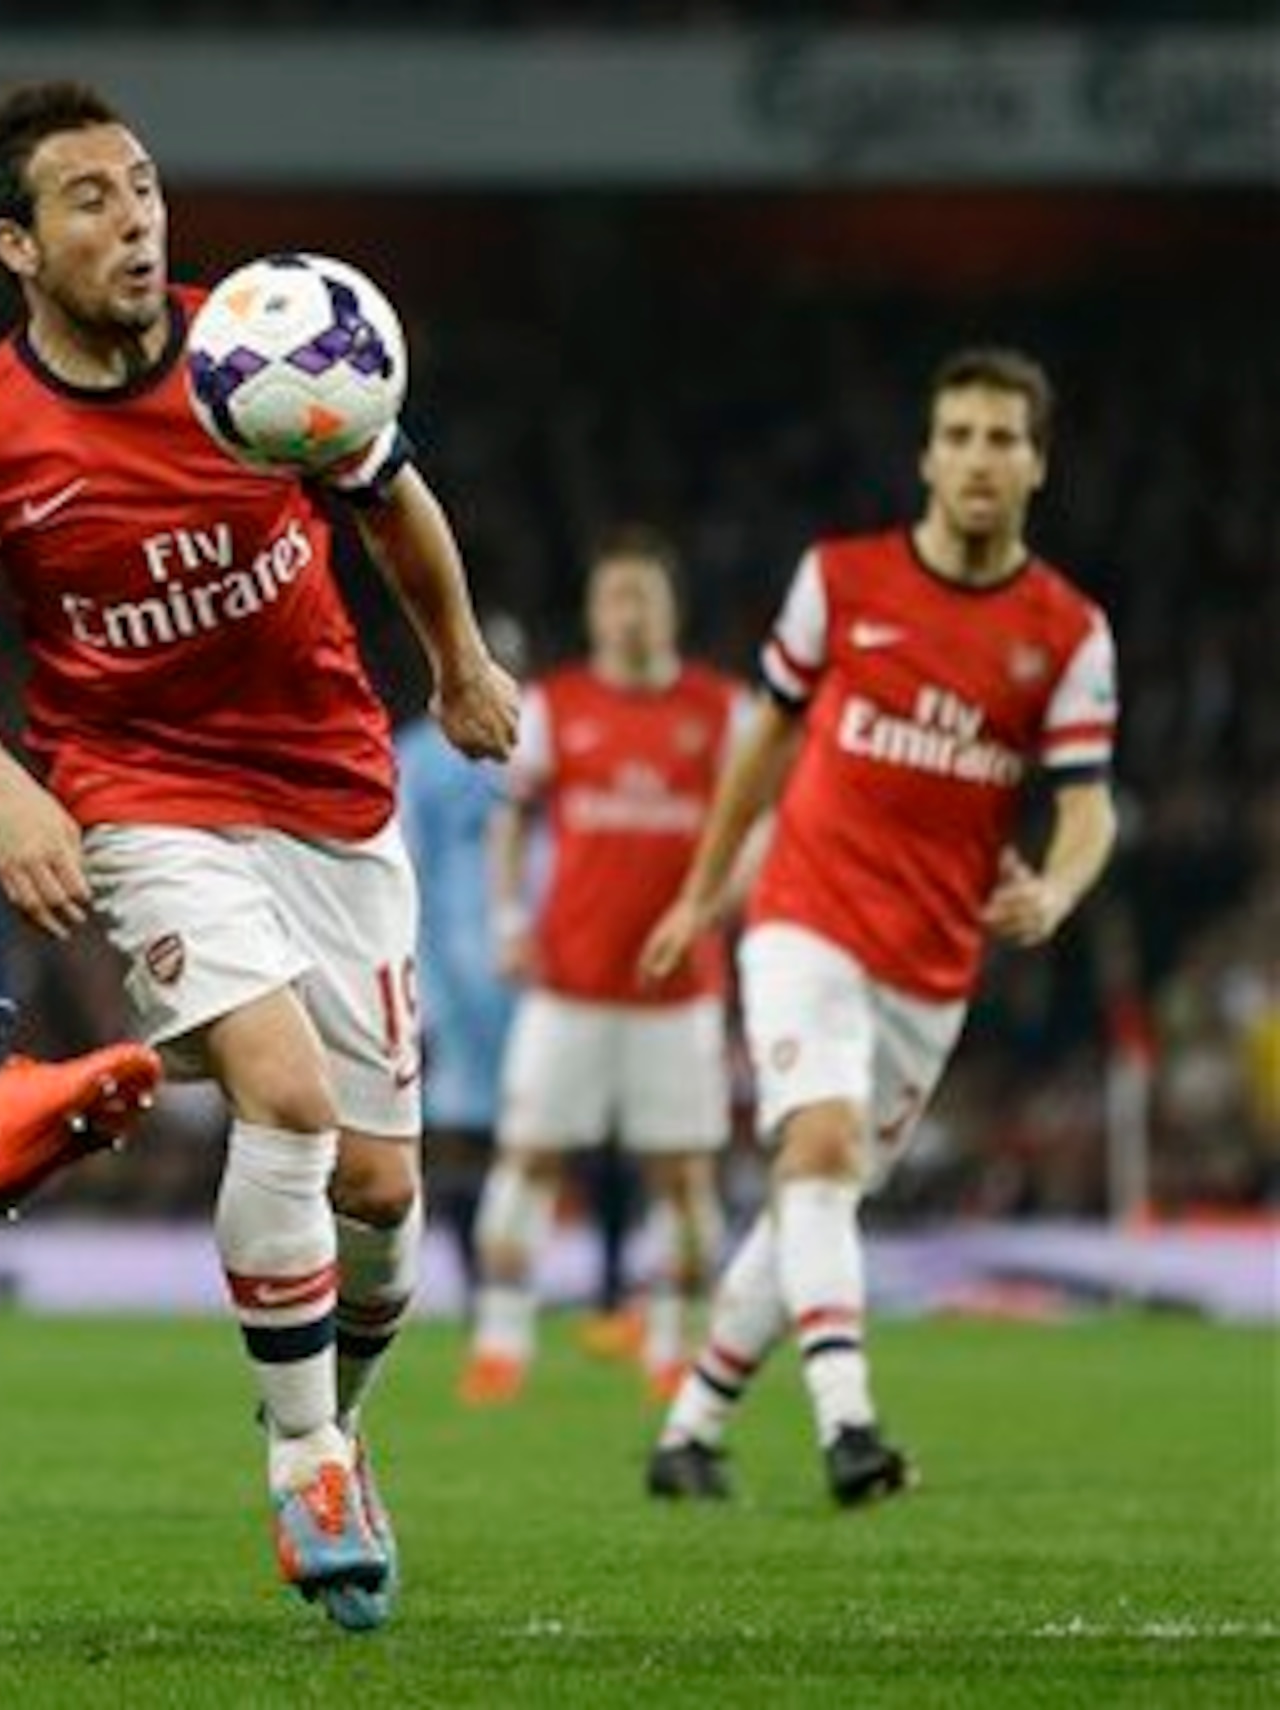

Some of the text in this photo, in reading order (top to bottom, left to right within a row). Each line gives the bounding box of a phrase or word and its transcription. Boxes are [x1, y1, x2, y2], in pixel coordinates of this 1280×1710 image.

[61, 518, 312, 648] Emirates
[142, 521, 233, 583] Fly
[837, 696, 1025, 788] Emirate
[915, 682, 987, 745] Fly
